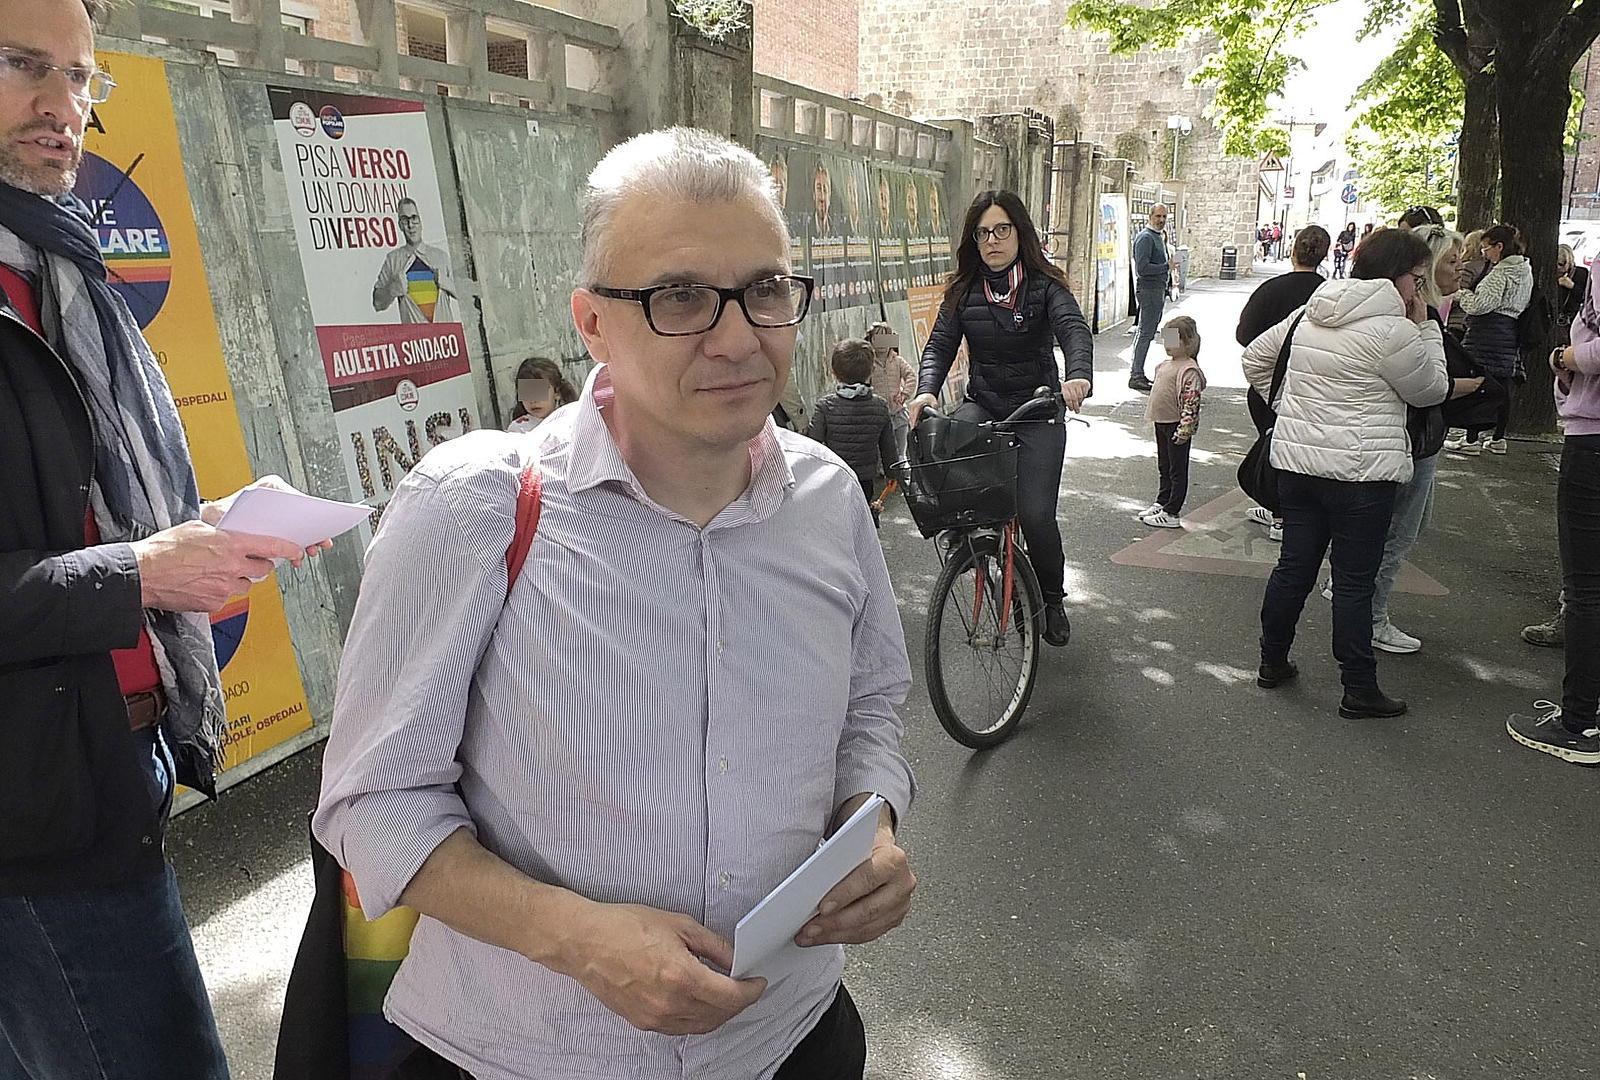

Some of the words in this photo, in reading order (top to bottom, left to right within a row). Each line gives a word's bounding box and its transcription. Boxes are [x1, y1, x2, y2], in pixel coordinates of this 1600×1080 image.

[295, 143, 343, 178] PISA
[343, 146, 411, 180] VERSO
[302, 180, 334, 214] UN
[92, 228, 162, 254] LARE
[310, 216, 398, 250] DIVERSO
[332, 343, 400, 378] AULETTA
[401, 334, 459, 366] SINDACO
[174, 391, 227, 407] OSPEDALI
[228, 713, 251, 732] TARI
[256, 702, 303, 731] OSPEDALI
